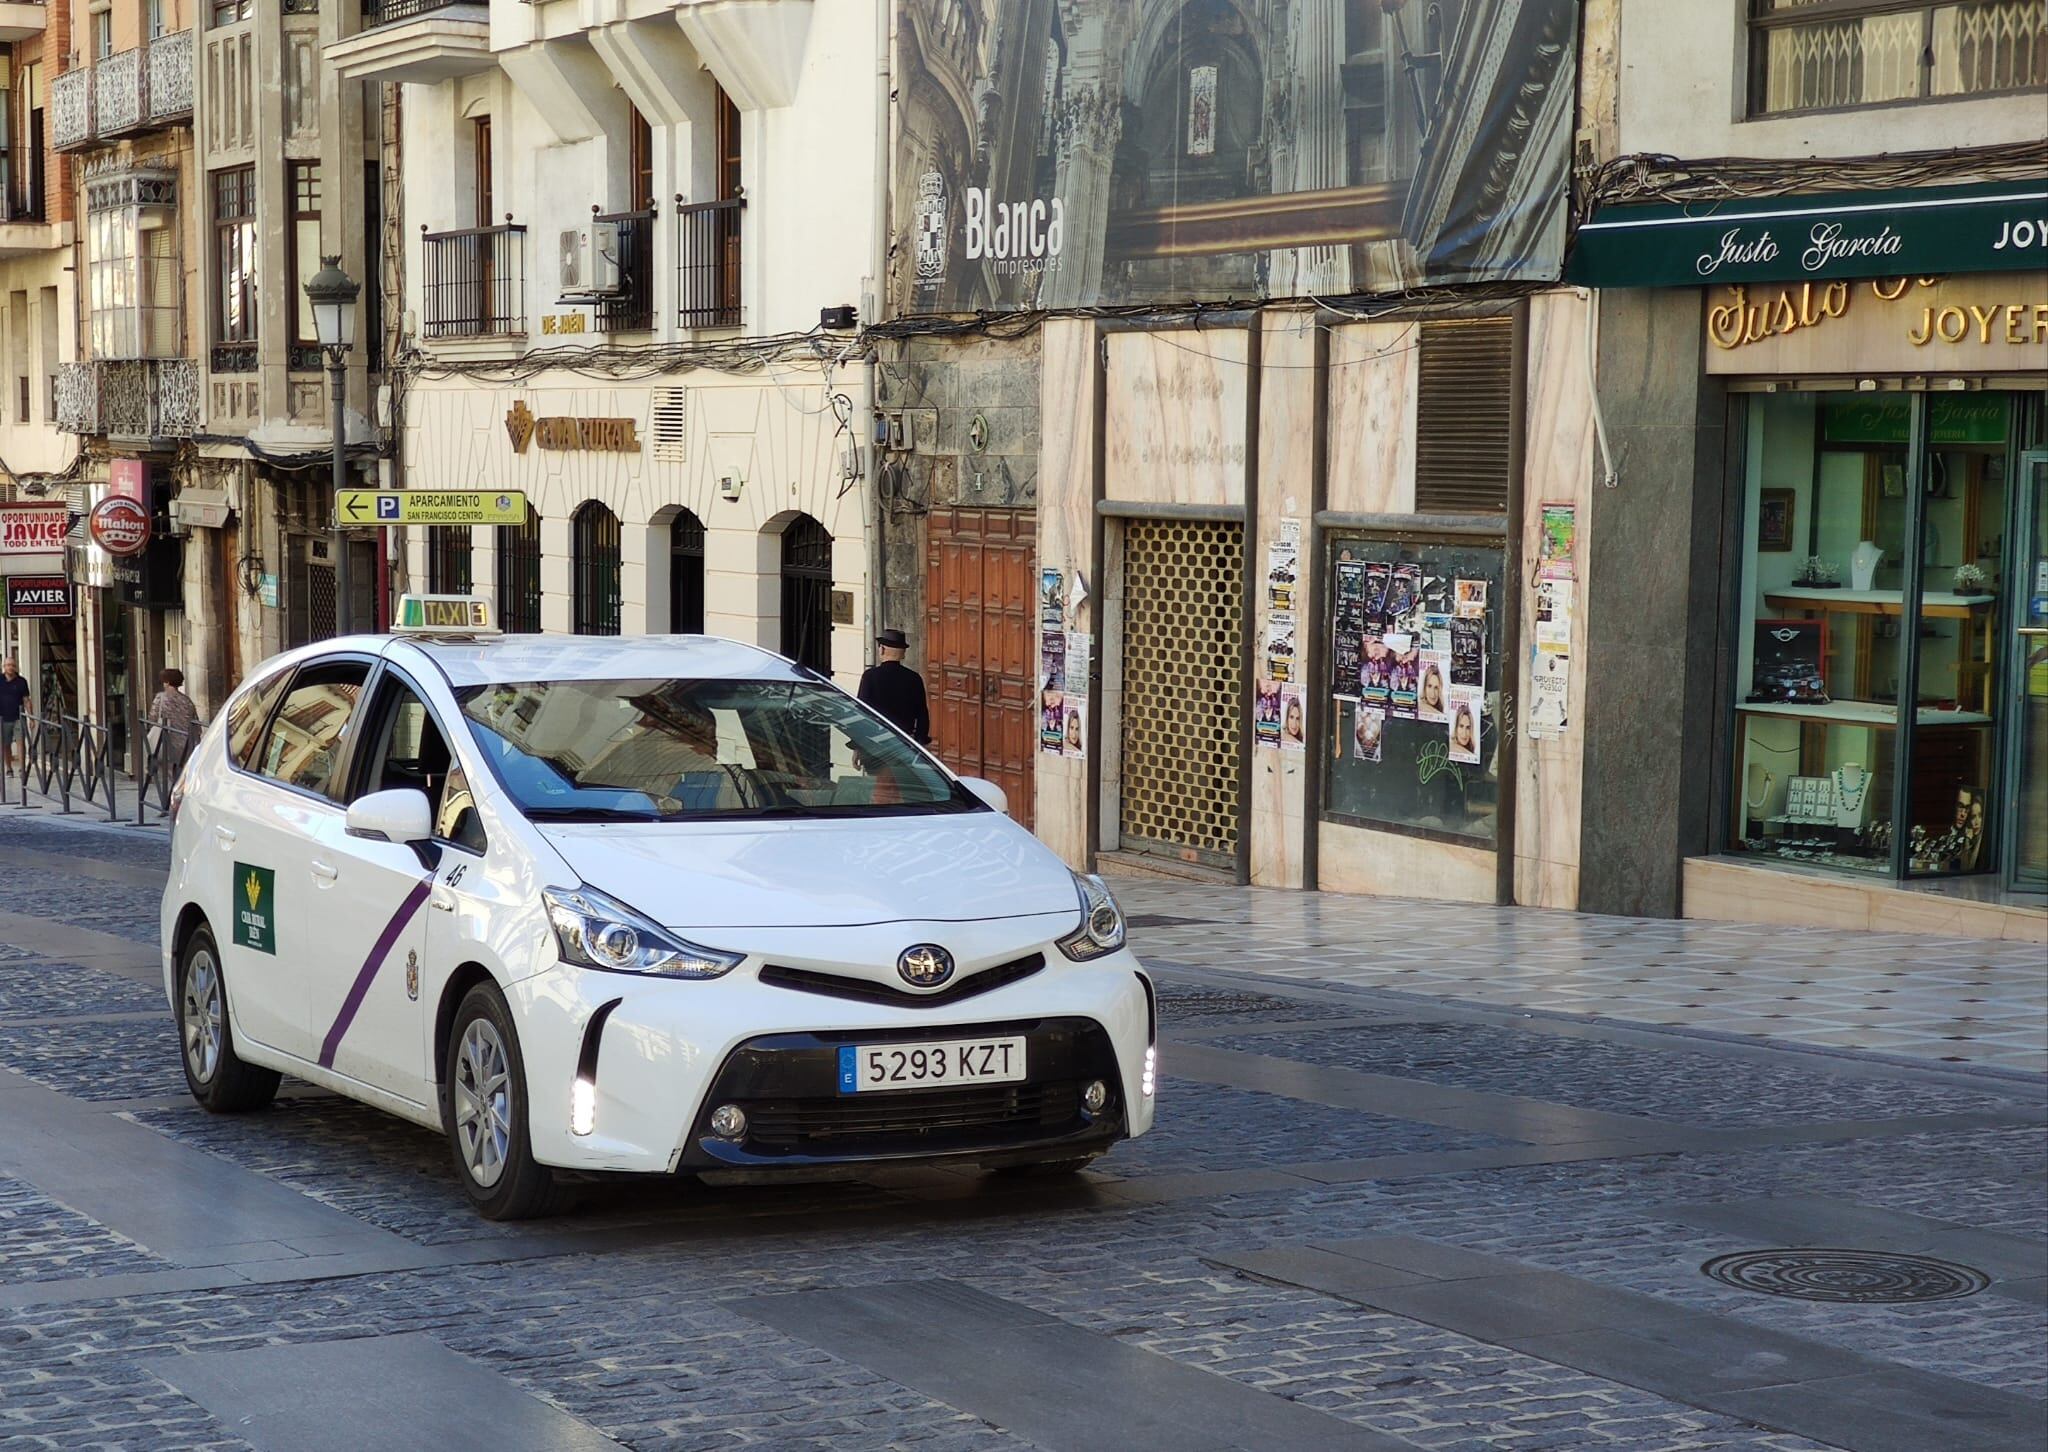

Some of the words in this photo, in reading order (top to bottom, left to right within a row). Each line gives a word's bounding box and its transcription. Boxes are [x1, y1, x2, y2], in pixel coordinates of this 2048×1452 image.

[966, 187, 1064, 259] Blanca
[1696, 228, 1779, 275] Justo
[1801, 222, 1902, 271] García
[1993, 219, 2048, 249] JOY
[994, 257, 1063, 279] impresores
[542, 315, 556, 335] DE
[560, 309, 585, 334] JAÉN
[1908, 304, 2048, 345] JOYER
[536, 417, 577, 451] CAJA
[577, 417, 641, 452] RURAL
[380, 497, 396, 517] P
[409, 495, 480, 508] APARCAMIENTO
[98, 517, 144, 530] Mahou
[407, 511, 420, 520] SAN
[421, 511, 457, 520] FRANCISCO
[458, 511, 484, 520] CENTRO
[15, 590, 65, 602] JAVIER
[427, 602, 467, 625] TAXI
[446, 863, 467, 887] 46
[869, 1048, 947, 1083] 5293
[959, 1044, 1014, 1077] KZT
[844, 1074, 852, 1083] E
